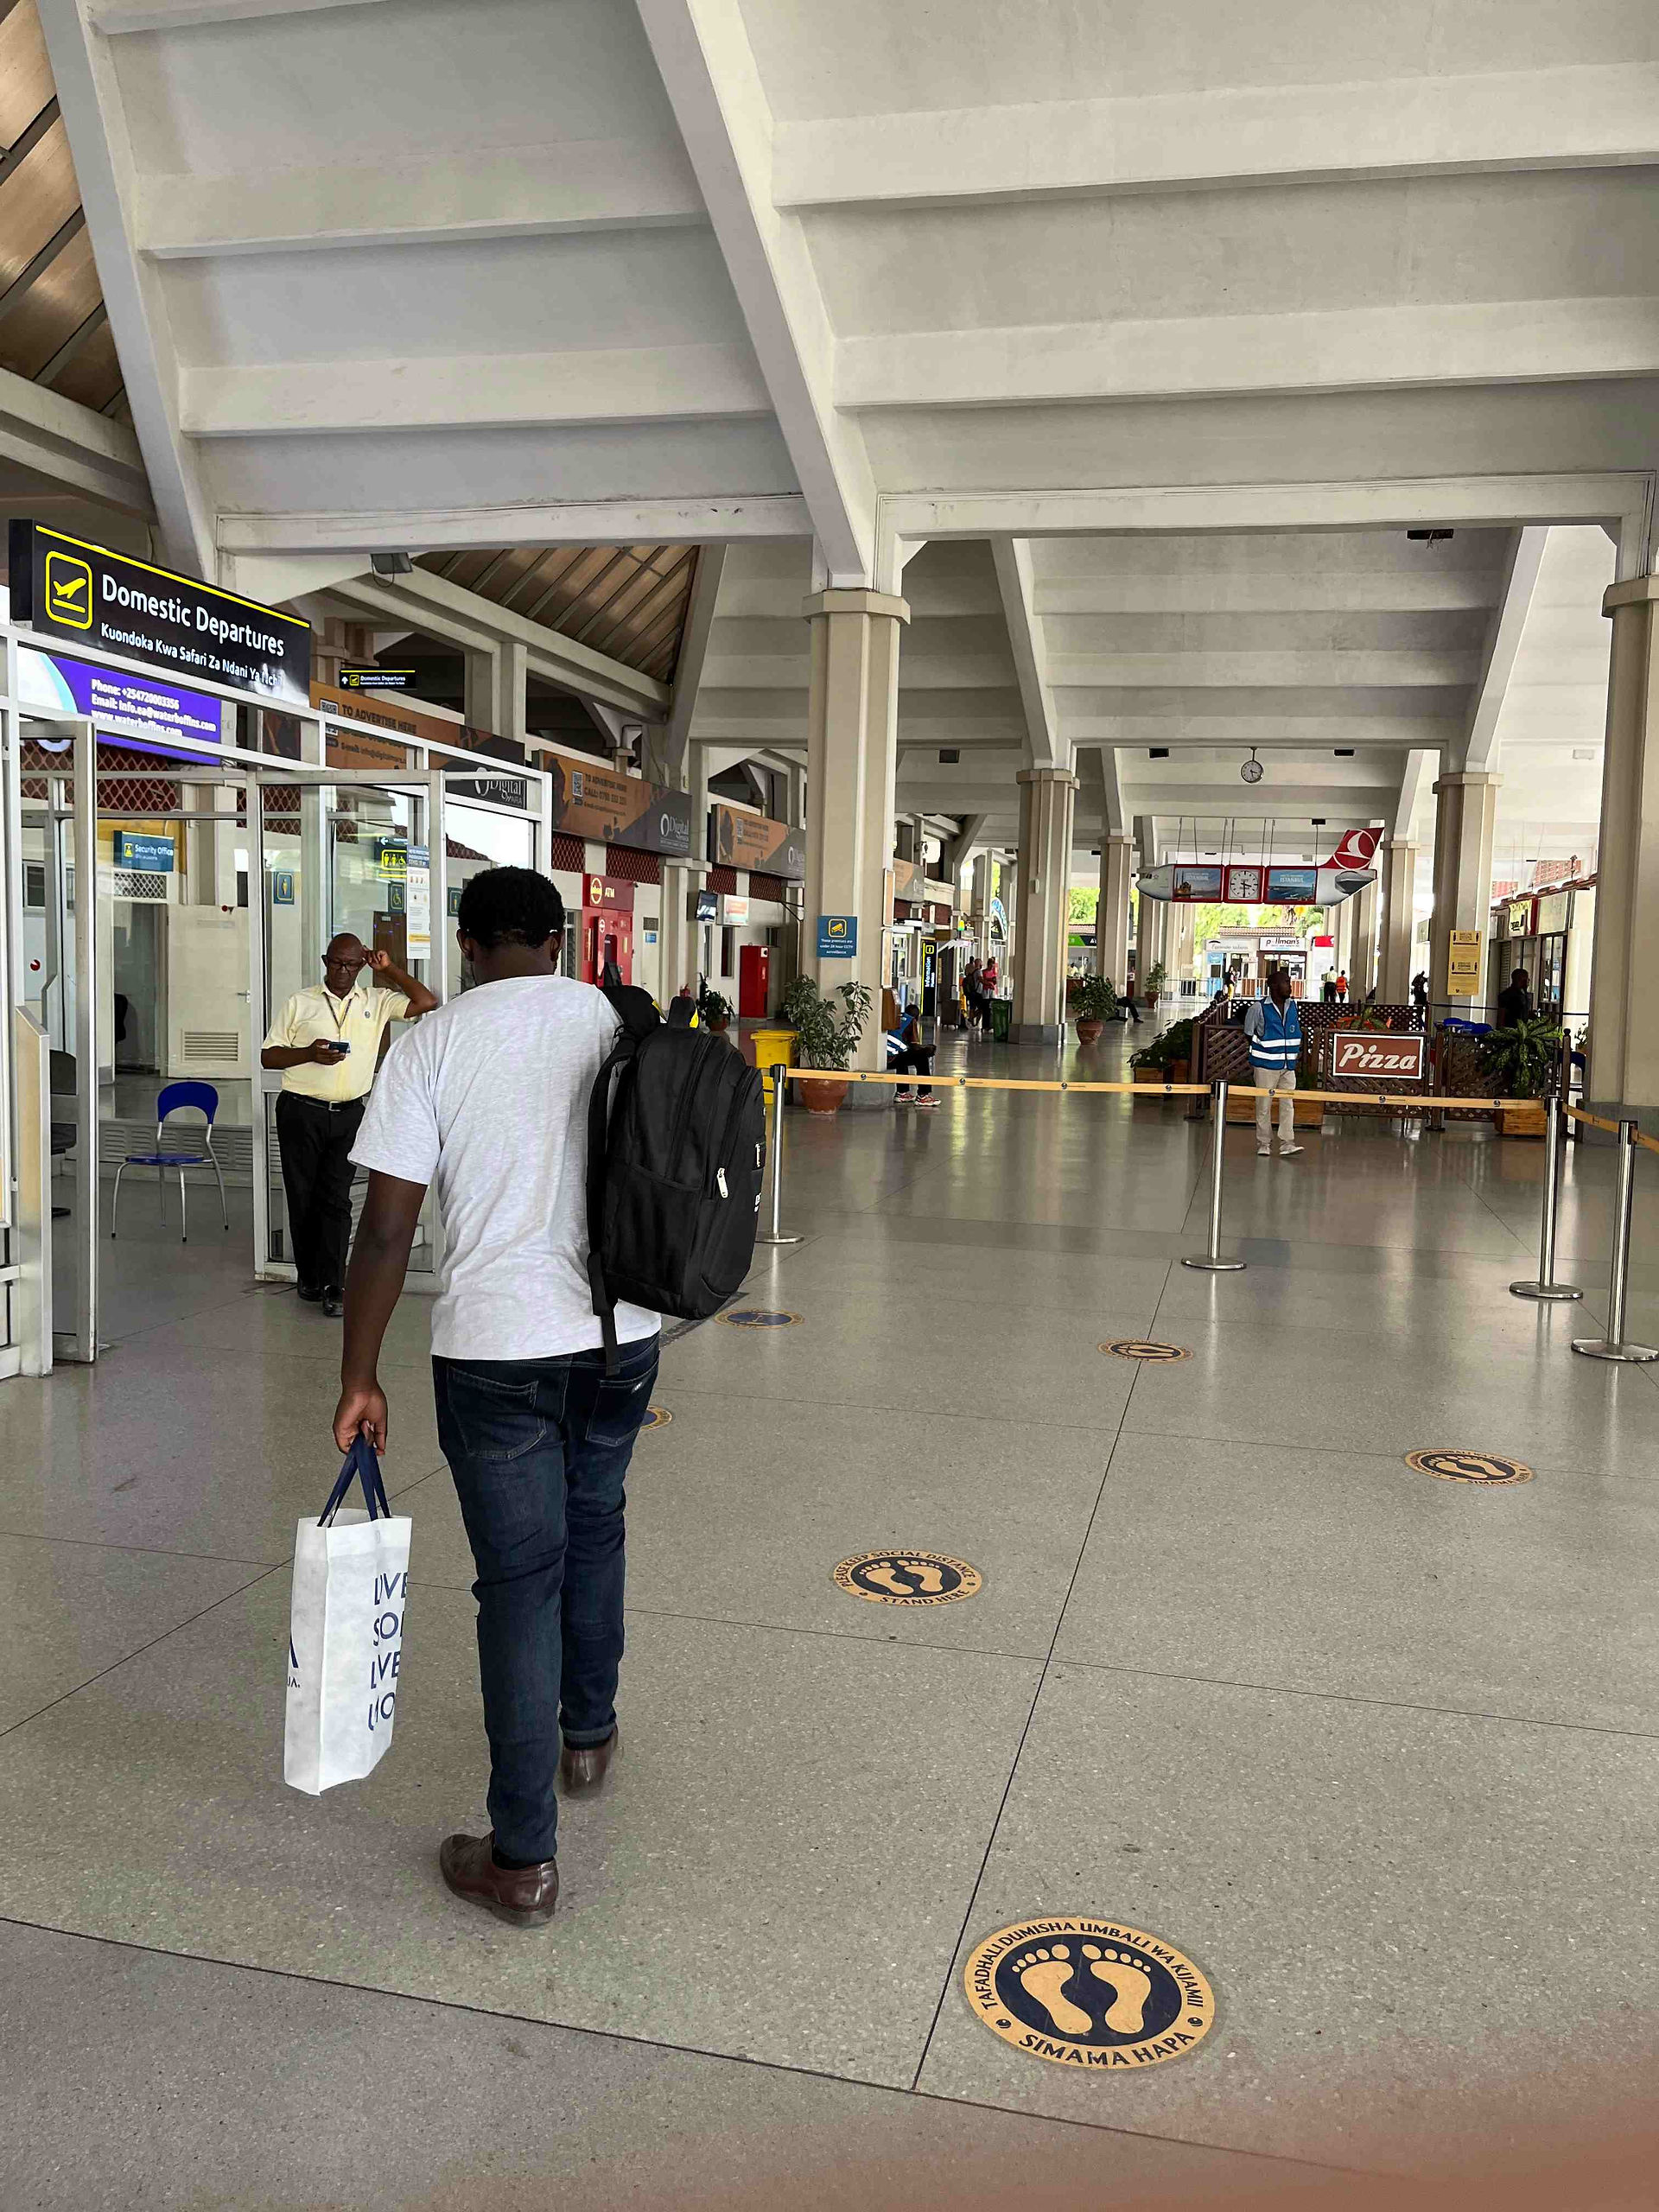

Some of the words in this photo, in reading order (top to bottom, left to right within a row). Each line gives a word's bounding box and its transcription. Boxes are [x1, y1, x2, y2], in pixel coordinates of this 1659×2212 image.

[102, 574, 191, 627] Domestic
[196, 606, 284, 657] Departures
[101, 622, 154, 652] Kuondoka
[156, 639, 178, 658] Kwa
[180, 645, 207, 667] Safari
[208, 654, 220, 671] Za
[222, 658, 248, 678] Ndani
[250, 666, 260, 683] Ya
[91, 678, 122, 696] Phone:
[91, 693, 118, 710] Email:
[341, 704, 353, 716] TO
[135, 844, 156, 856] Security
[157, 847, 174, 856] Office
[605, 887, 615, 898] ATM
[1265, 937, 1300, 946] pllman's
[1338, 1043, 1418, 1070] Pizza
[926, 1554, 976, 1578] DISTANCE
[880, 1597, 934, 1605] STAND
[936, 1589, 969, 1603] HERE
[975, 1942, 1004, 2010] TAFADHALI
[998, 1921, 1077, 1948] DUMISHA
[1079, 1922, 1150, 1948] UMBALI
[1151, 1944, 1176, 1965] WA
[1172, 1961, 1204, 2008] KIJAMII
[1018, 2033, 1131, 2066] SIMAMA
[1131, 2031, 1196, 2063] HAPA
